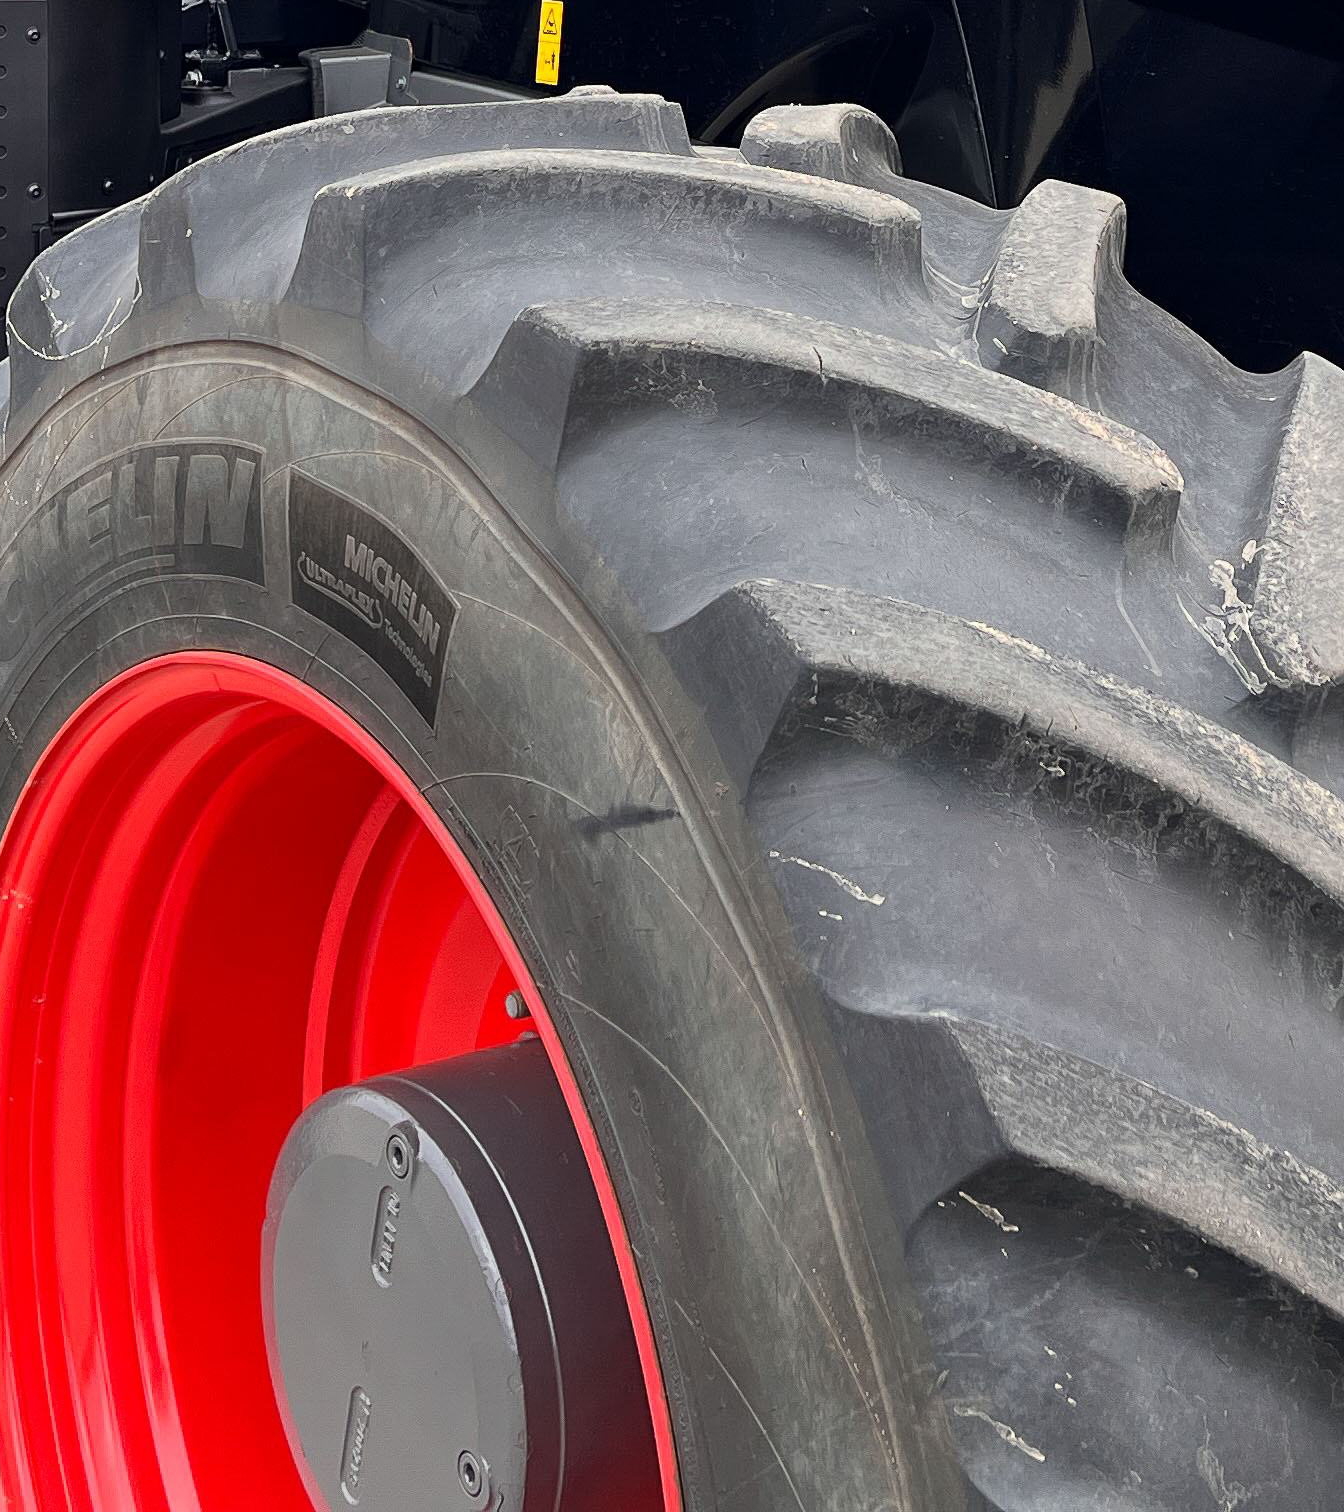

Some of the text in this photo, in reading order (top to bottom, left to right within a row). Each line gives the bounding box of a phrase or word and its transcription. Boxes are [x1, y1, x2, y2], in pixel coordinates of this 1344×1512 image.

[306, 556, 375, 620] ULTRAFLEX
[344, 534, 441, 656] MICHELIN
[385, 618, 433, 688] Technologies
